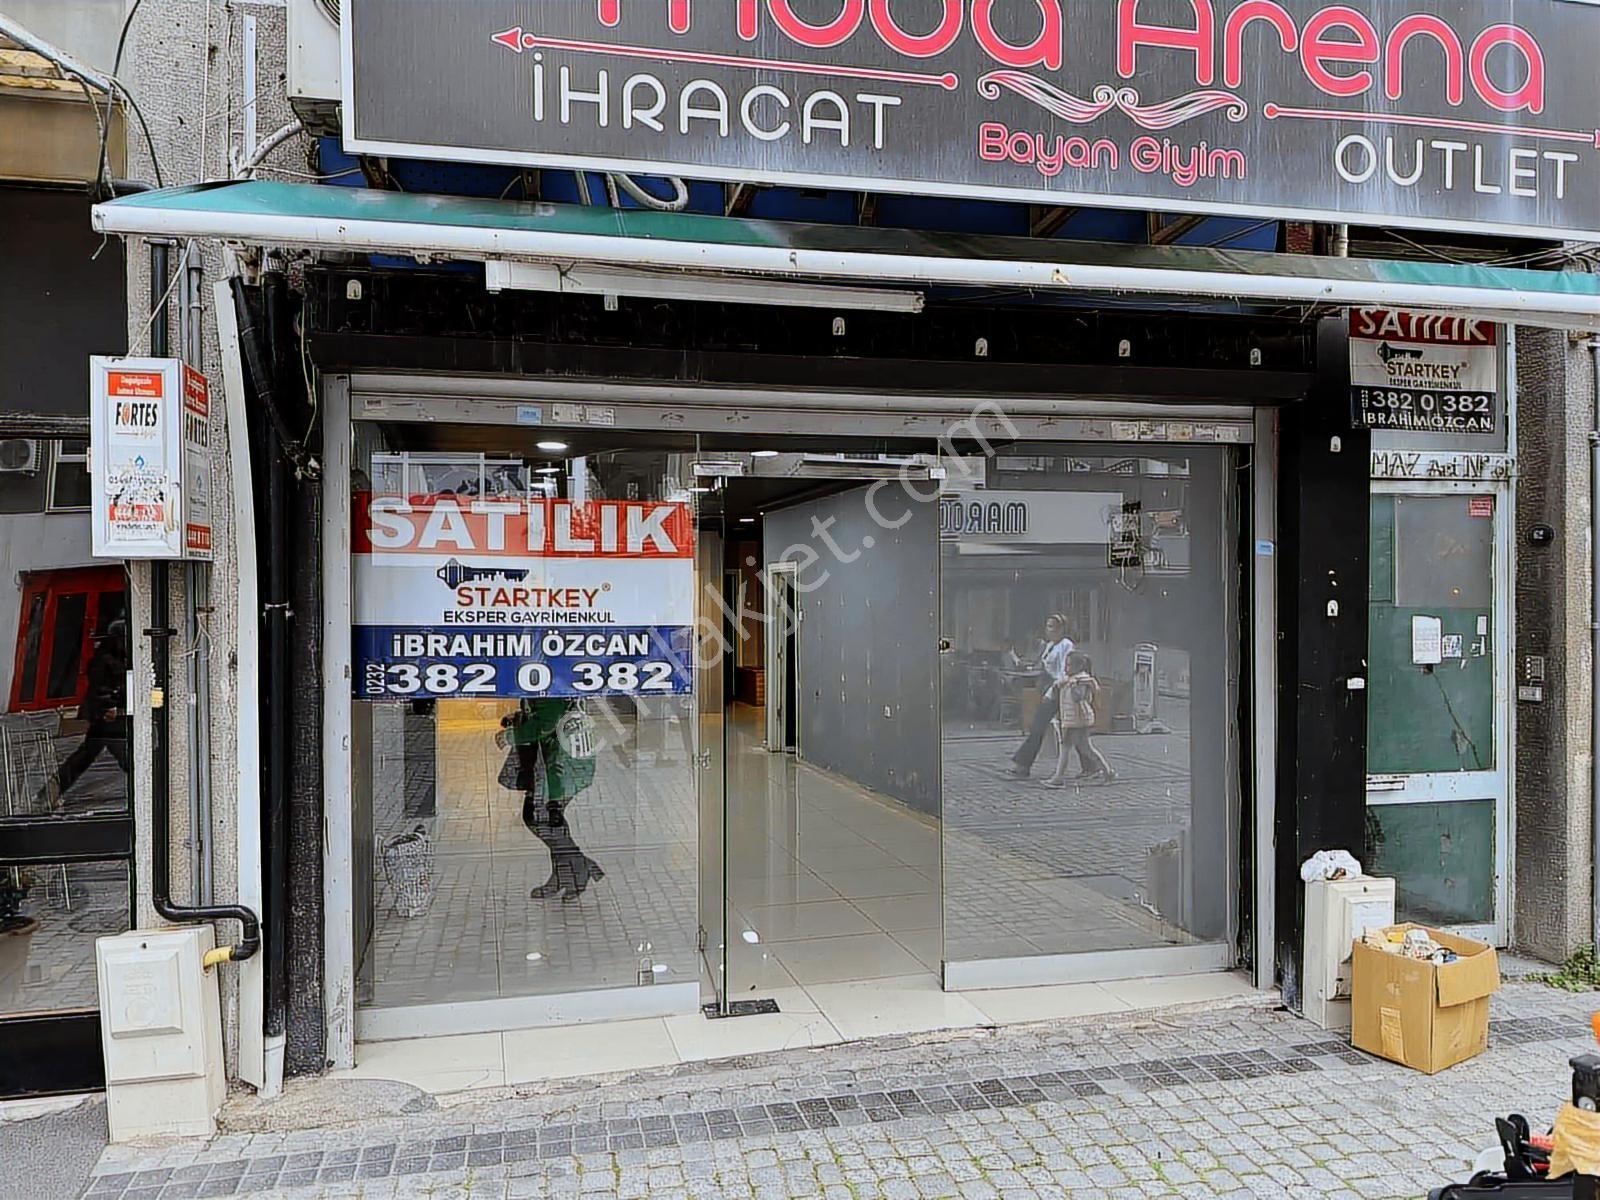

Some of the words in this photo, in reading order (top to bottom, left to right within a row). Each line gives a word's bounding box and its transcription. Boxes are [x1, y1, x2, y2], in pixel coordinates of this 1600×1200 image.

[1117, 0, 1545, 115] Arena
[979, 122, 1119, 177] Bayan
[1129, 135, 1247, 187] Giyim
[1334, 133, 1580, 200] OUTLET
[1387, 361, 1460, 379] STARTKEY
[1372, 390, 1413, 410] 382
[1420, 394, 1434, 411] 0
[1443, 395, 1489, 412] 382
[1431, 413, 1491, 429] ÖZCAN
[457, 586, 600, 608] STARTKEY
[443, 610, 506, 624] EKSPER
[510, 609, 616, 624] GAYRİMENKUL
[542, 629, 650, 657] ÖZCAN
[366, 663, 385, 694] 0232
[387, 663, 497, 693] 382
[517, 662, 552, 692] 0
[572, 661, 673, 691] 382
